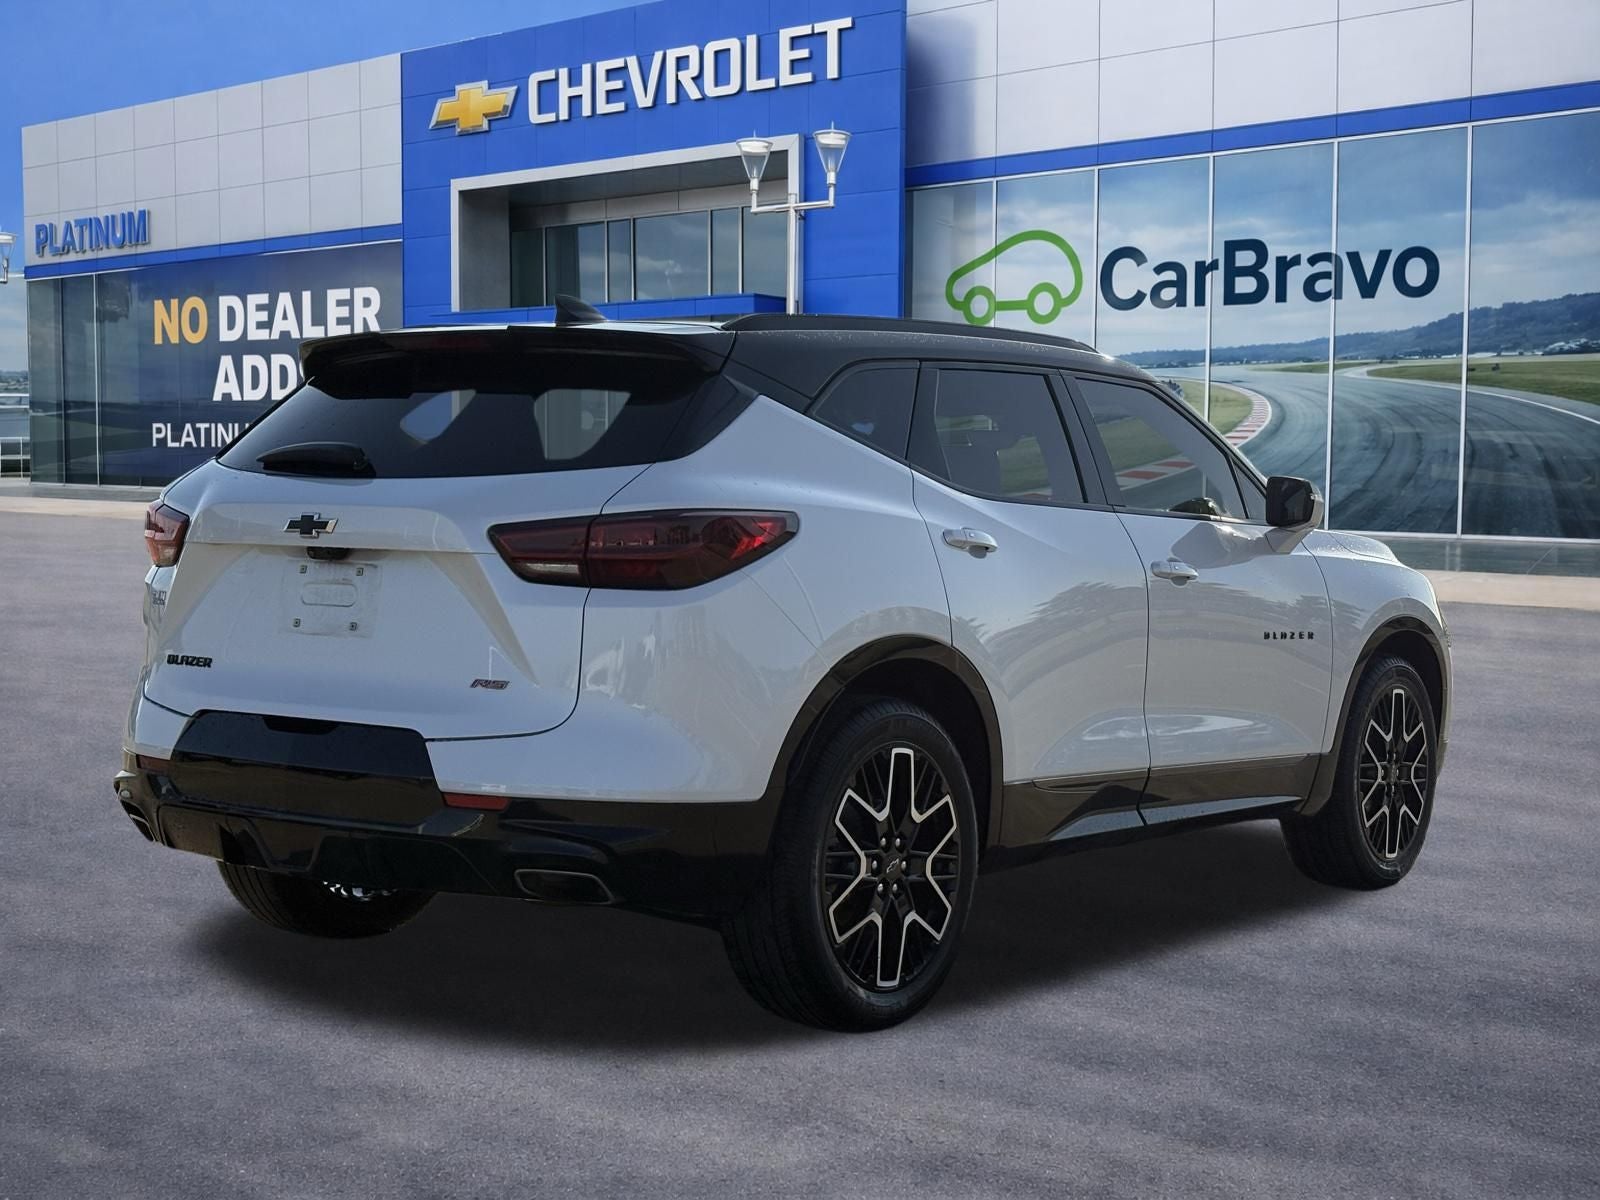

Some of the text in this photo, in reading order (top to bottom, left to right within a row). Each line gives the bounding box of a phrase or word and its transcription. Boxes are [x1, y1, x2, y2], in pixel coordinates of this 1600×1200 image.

[528, 17, 853, 125] CHEVROLET
[35, 209, 149, 256] PLATINUM
[1100, 238, 1440, 311] CarBravo
[153, 287, 381, 344] NO DEALER
[152, 423, 250, 448] PLATIN
[1263, 631, 1314, 640] BLAZER
[167, 654, 212, 668] BLAZER
